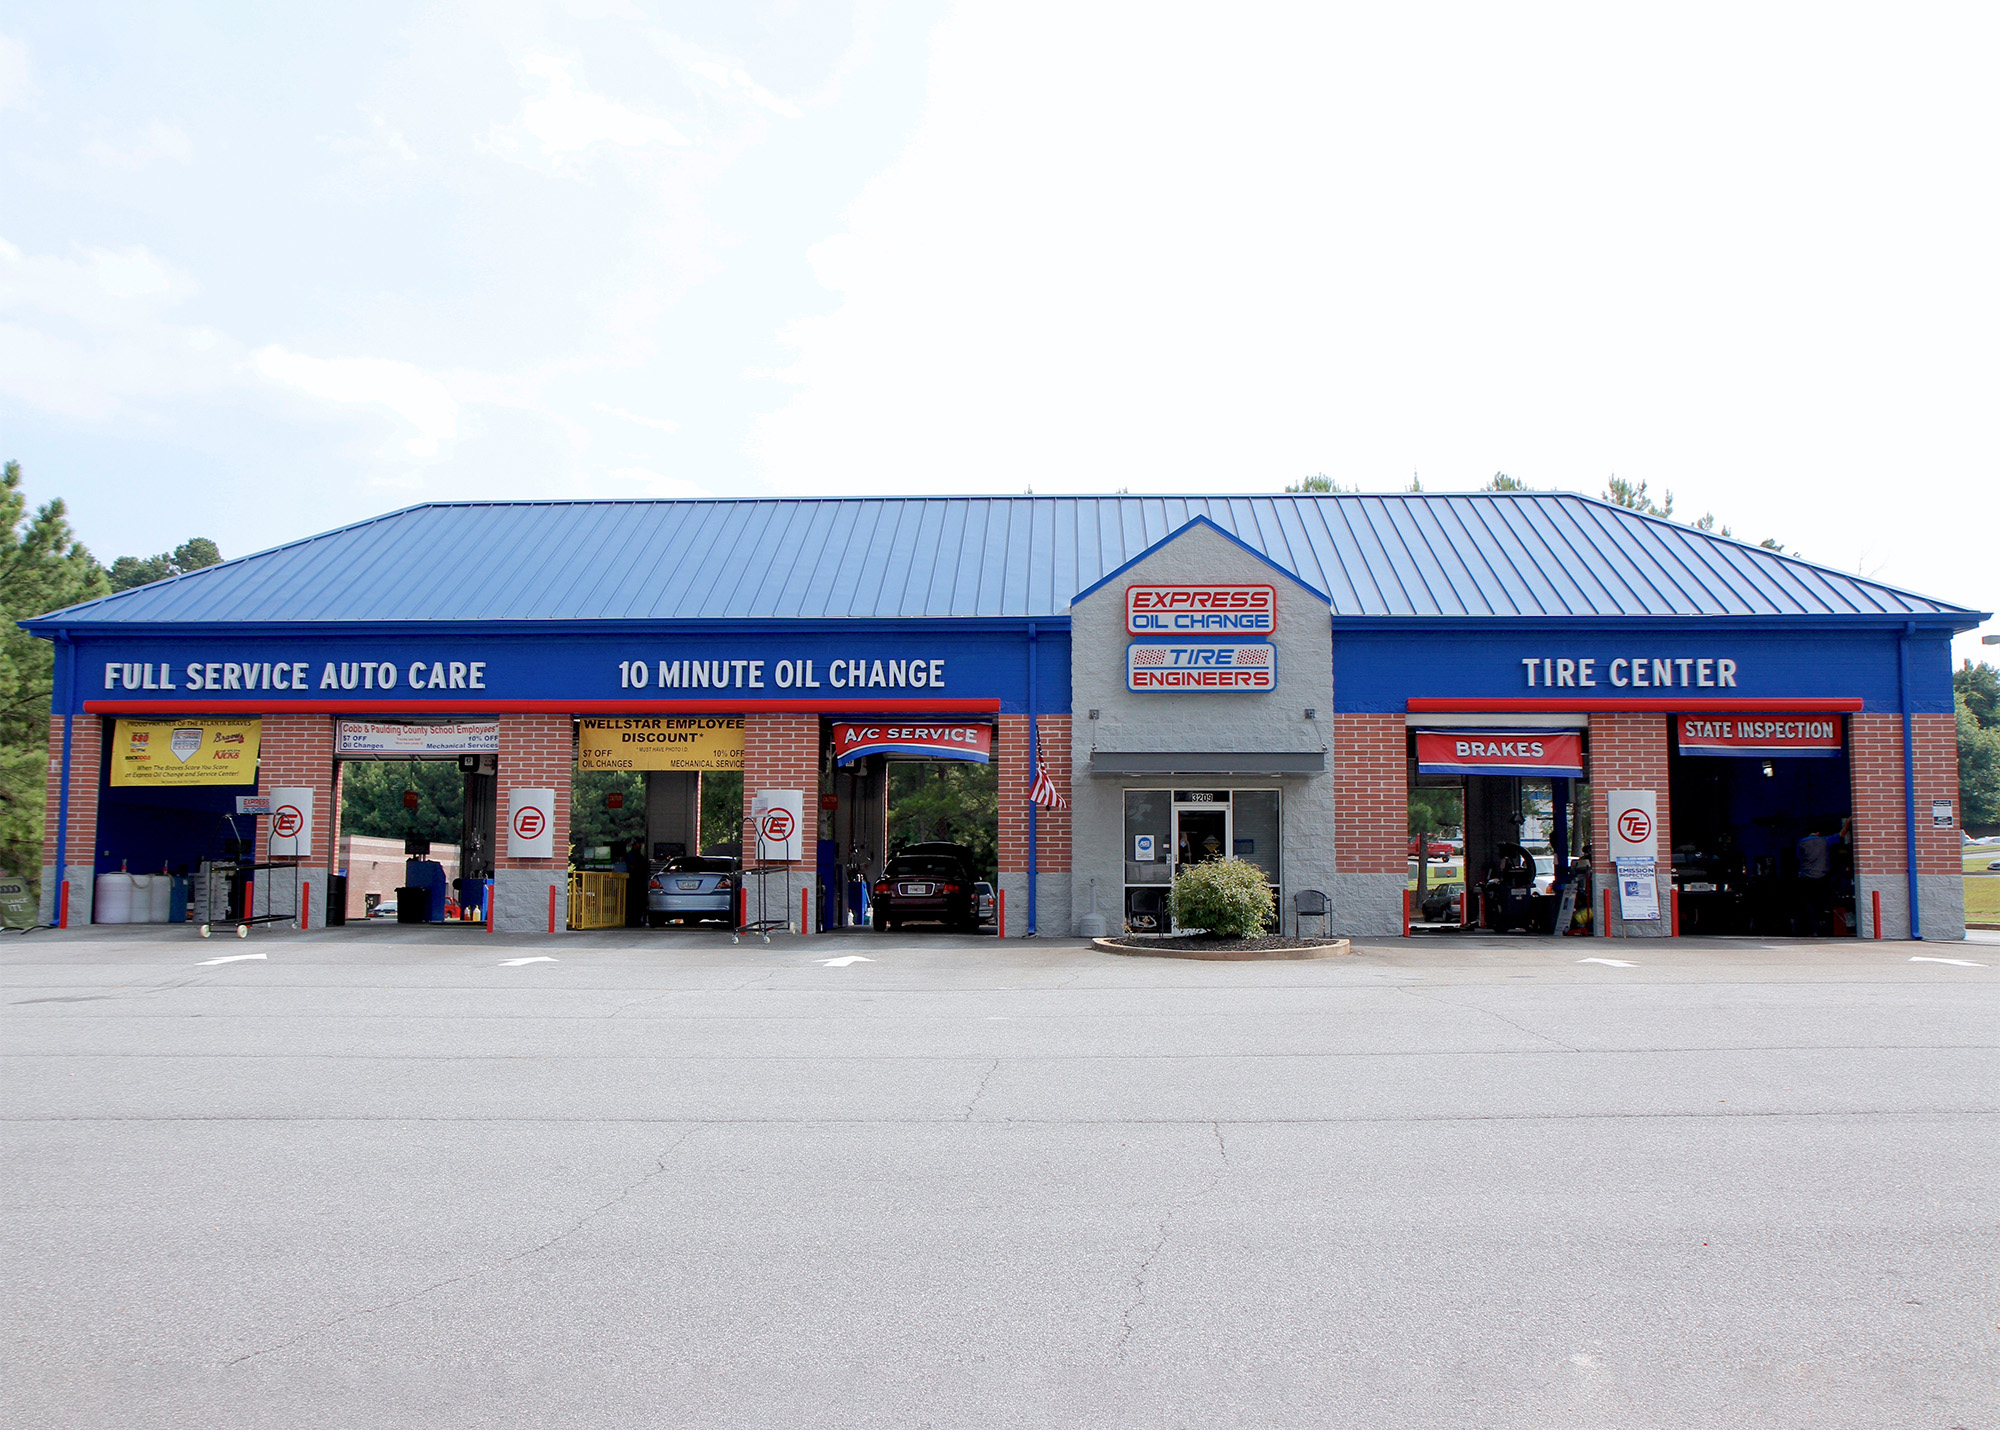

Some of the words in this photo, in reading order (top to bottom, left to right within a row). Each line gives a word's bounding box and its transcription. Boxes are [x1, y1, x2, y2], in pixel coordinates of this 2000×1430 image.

[1133, 592, 1270, 608] EXPRESS
[1133, 615, 1169, 629] OIL
[1175, 615, 1270, 629] CHANGE
[1170, 649, 1235, 665] TIRE
[105, 663, 177, 690] FULL
[186, 662, 310, 690] SERVICE
[320, 662, 398, 690] AUTO
[409, 662, 487, 690] CARE
[619, 661, 649, 689] 10
[658, 661, 765, 689] MINUTE
[775, 660, 821, 688] OIL
[829, 659, 945, 688] CHANGE
[1133, 672, 1270, 686] ENGINEERS
[1522, 658, 1597, 687] TIRE
[1609, 658, 1737, 688] CENTER
[343, 724, 363, 733] Cobb
[364, 725, 370, 734] &
[371, 725, 401, 736] Paulding
[403, 725, 428, 735] County
[430, 724, 455, 734] School
[584, 720, 662, 729] WELLSTAR
[666, 720, 745, 729] EMPLOYEE
[1685, 721, 1733, 739] STATE
[1737, 722, 1834, 739] INSPECTION
[844, 728, 881, 744] A/C
[887, 728, 978, 744] SERVICE
[583, 750, 592, 758] $7
[713, 750, 728, 758] 10%
[1456, 742, 1544, 758] BRAKES
[582, 760, 594, 768] OIL
[597, 760, 633, 768] CHANGES
[670, 760, 714, 768] MECHANICAL
[716, 760, 744, 768] SERVICE
[1192, 793, 1213, 802] 3209
[278, 814, 298, 830] E
[520, 816, 540, 832] E
[769, 817, 789, 833] E
[1623, 817, 1647, 836] TE
